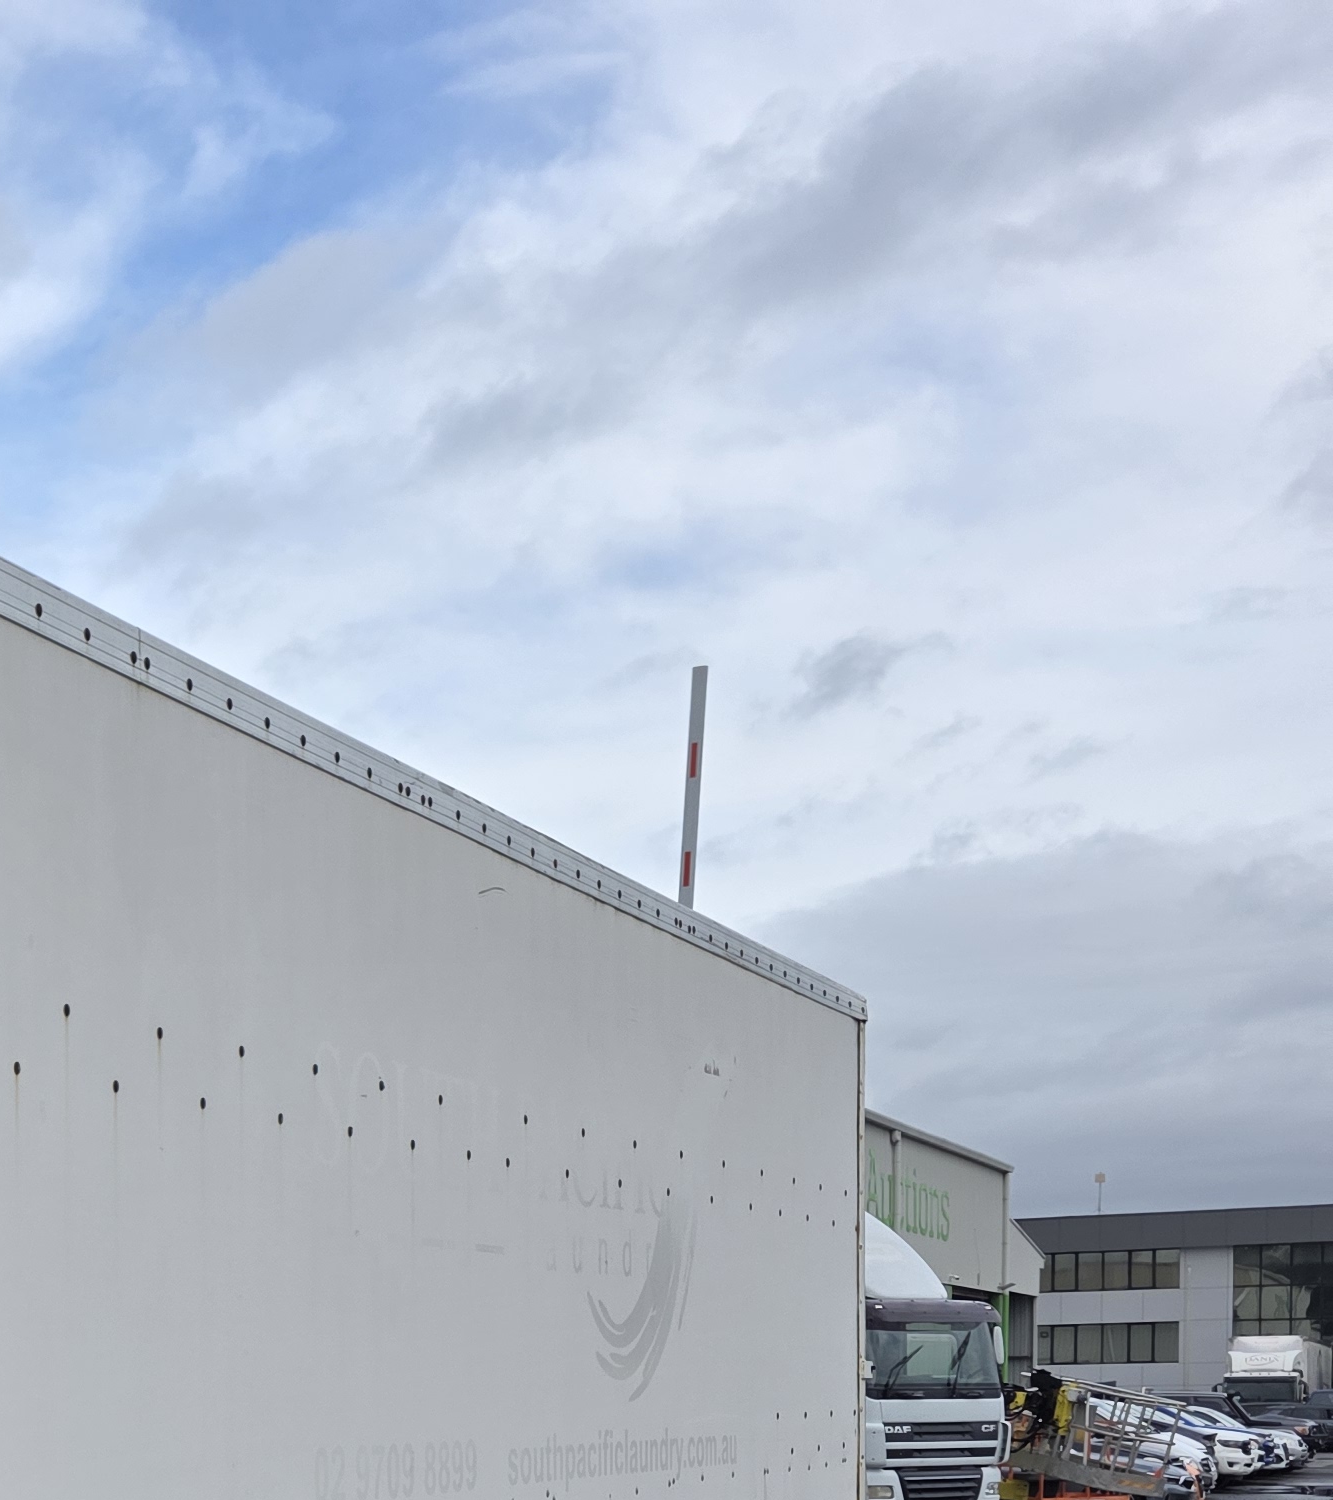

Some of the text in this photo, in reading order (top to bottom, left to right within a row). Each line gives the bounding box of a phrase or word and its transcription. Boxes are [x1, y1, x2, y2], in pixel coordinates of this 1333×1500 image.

[866, 1148, 950, 1242] Autions
[885, 1425, 911, 1434] DAF
[981, 1424, 996, 1432] CF
[355, 1443, 416, 1500] 9709
[423, 1439, 478, 1494] 8899
[507, 1429, 737, 1488] southpacificlaundry.com.au
